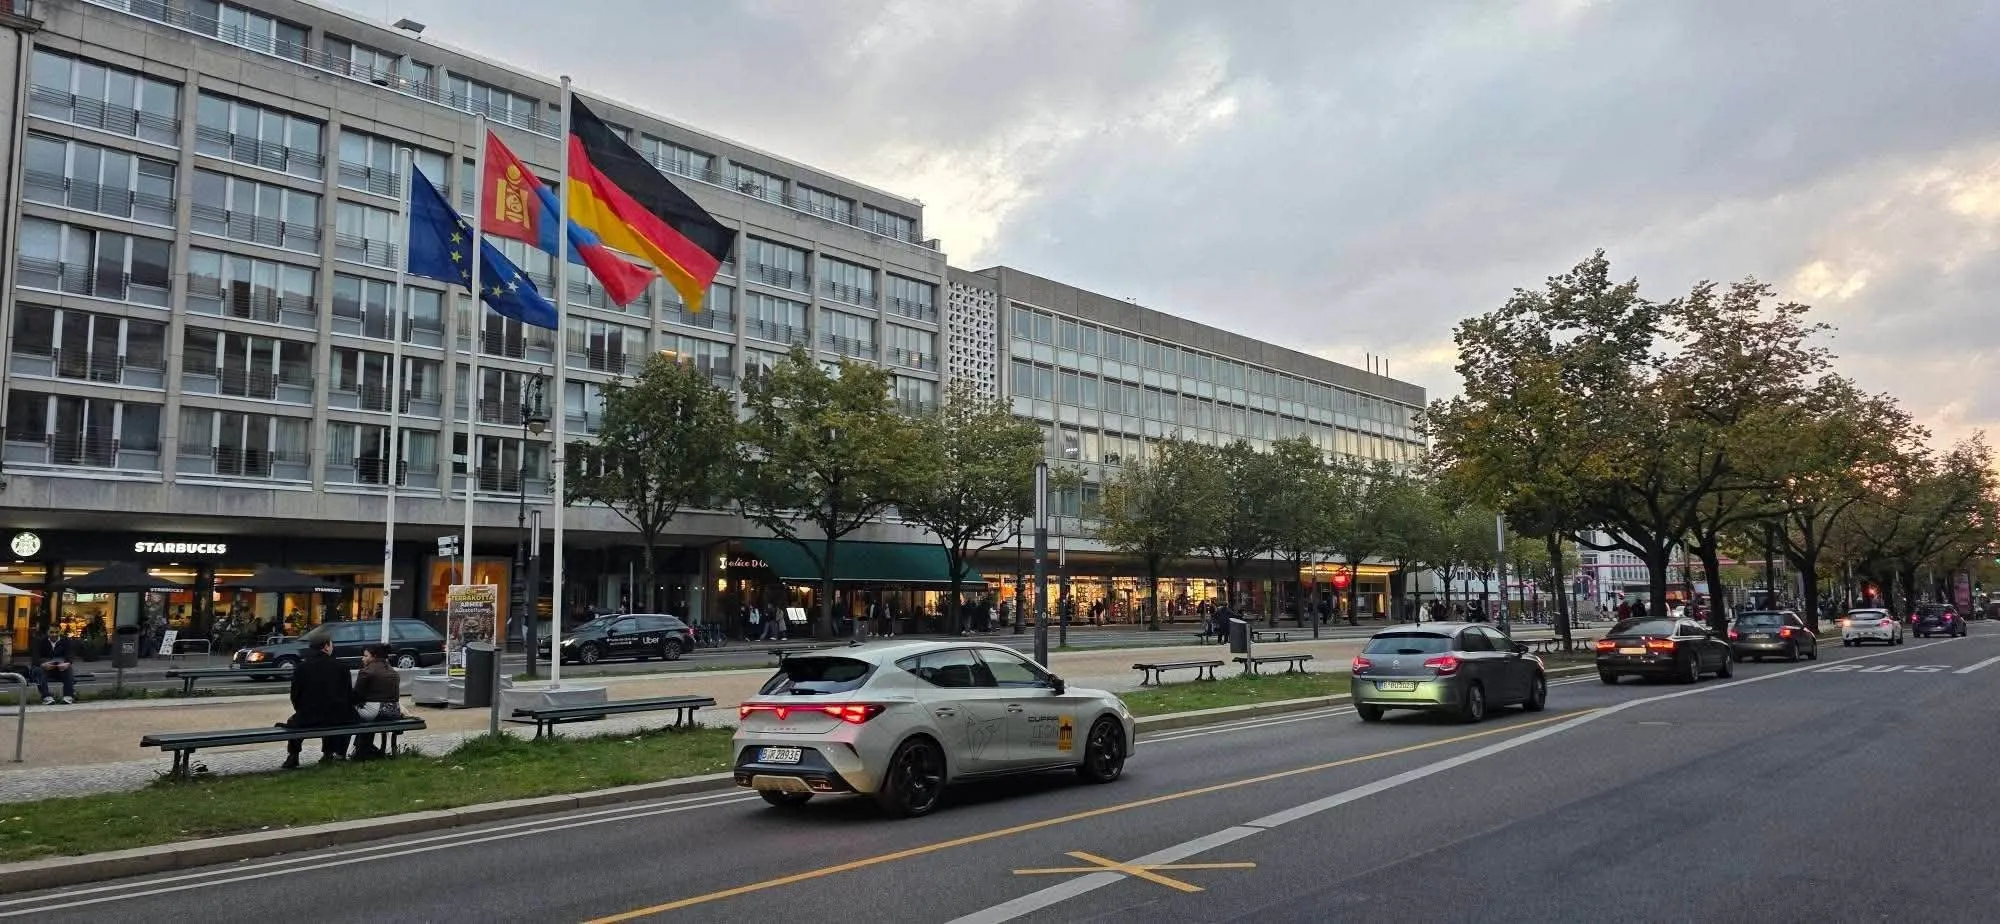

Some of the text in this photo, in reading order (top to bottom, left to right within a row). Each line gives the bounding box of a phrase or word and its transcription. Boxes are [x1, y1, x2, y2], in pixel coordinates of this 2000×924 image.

[134, 542, 227, 554] STARBUCKS
[642, 636, 660, 645] Uber
[1812, 664, 1953, 673] BUS
